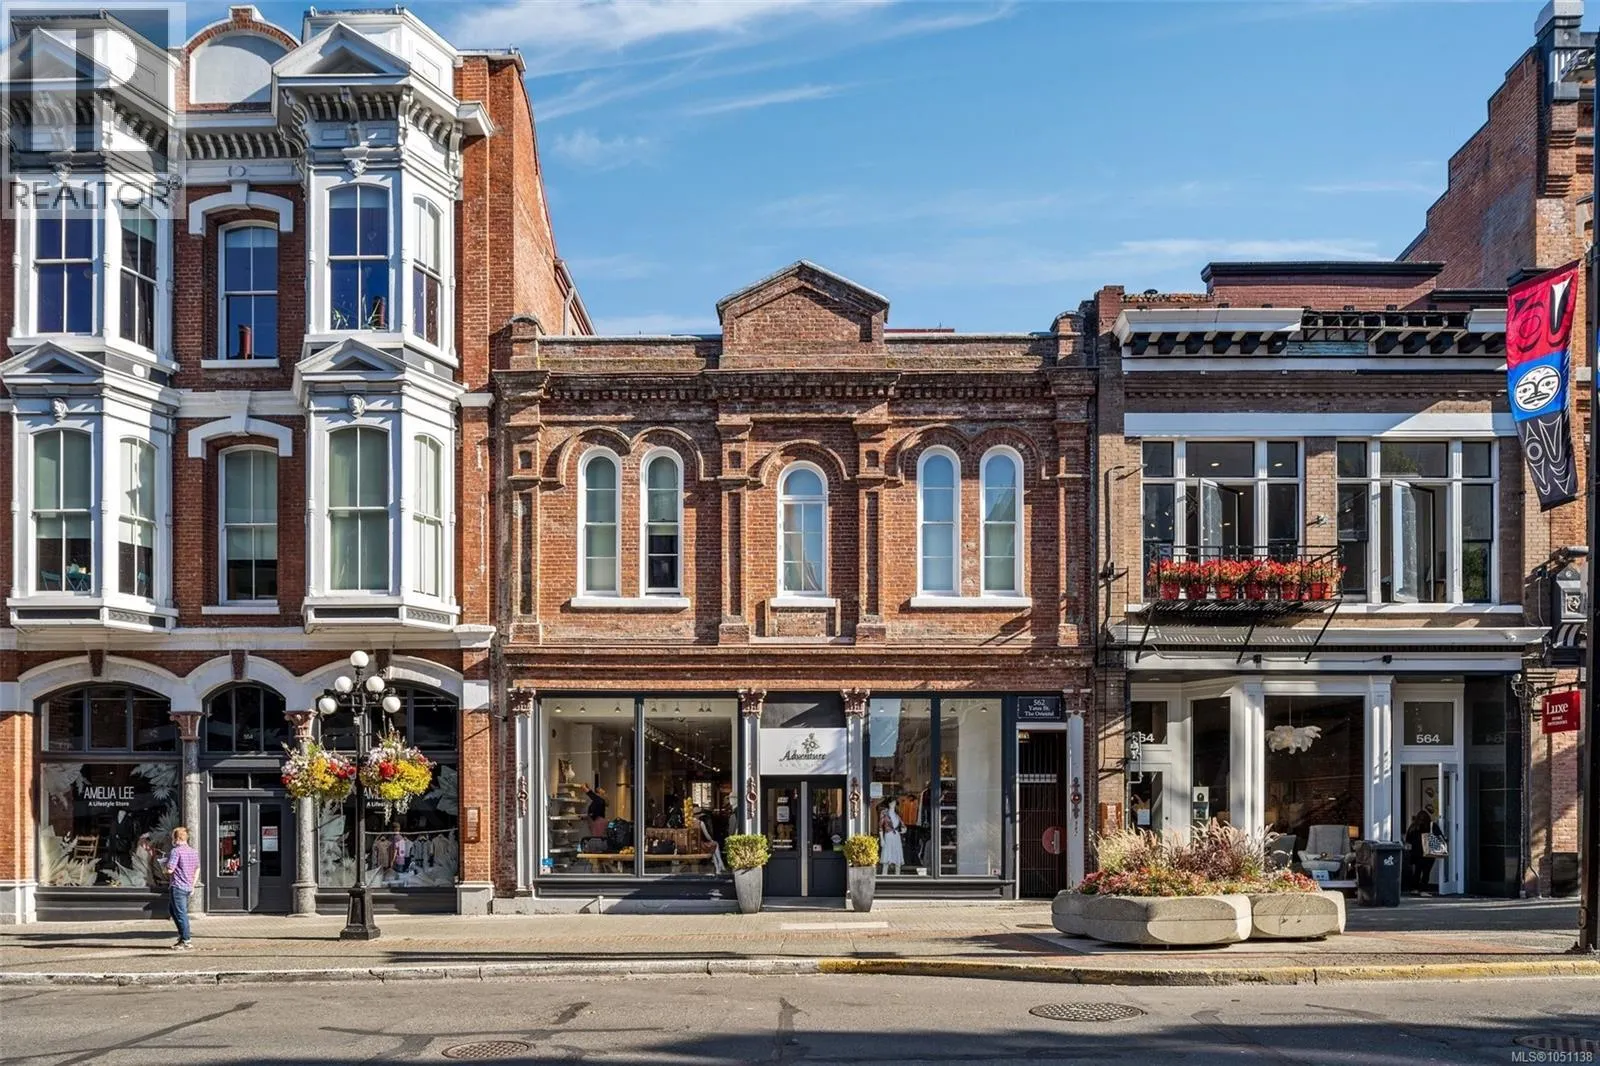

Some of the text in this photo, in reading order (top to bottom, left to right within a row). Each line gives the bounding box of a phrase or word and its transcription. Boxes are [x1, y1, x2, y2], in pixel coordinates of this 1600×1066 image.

[1546, 702, 1568, 715] Luxe
[1416, 734, 1441, 744] 564
[779, 749, 827, 762] Adventure
[83, 786, 135, 800] AMELIA LEE
